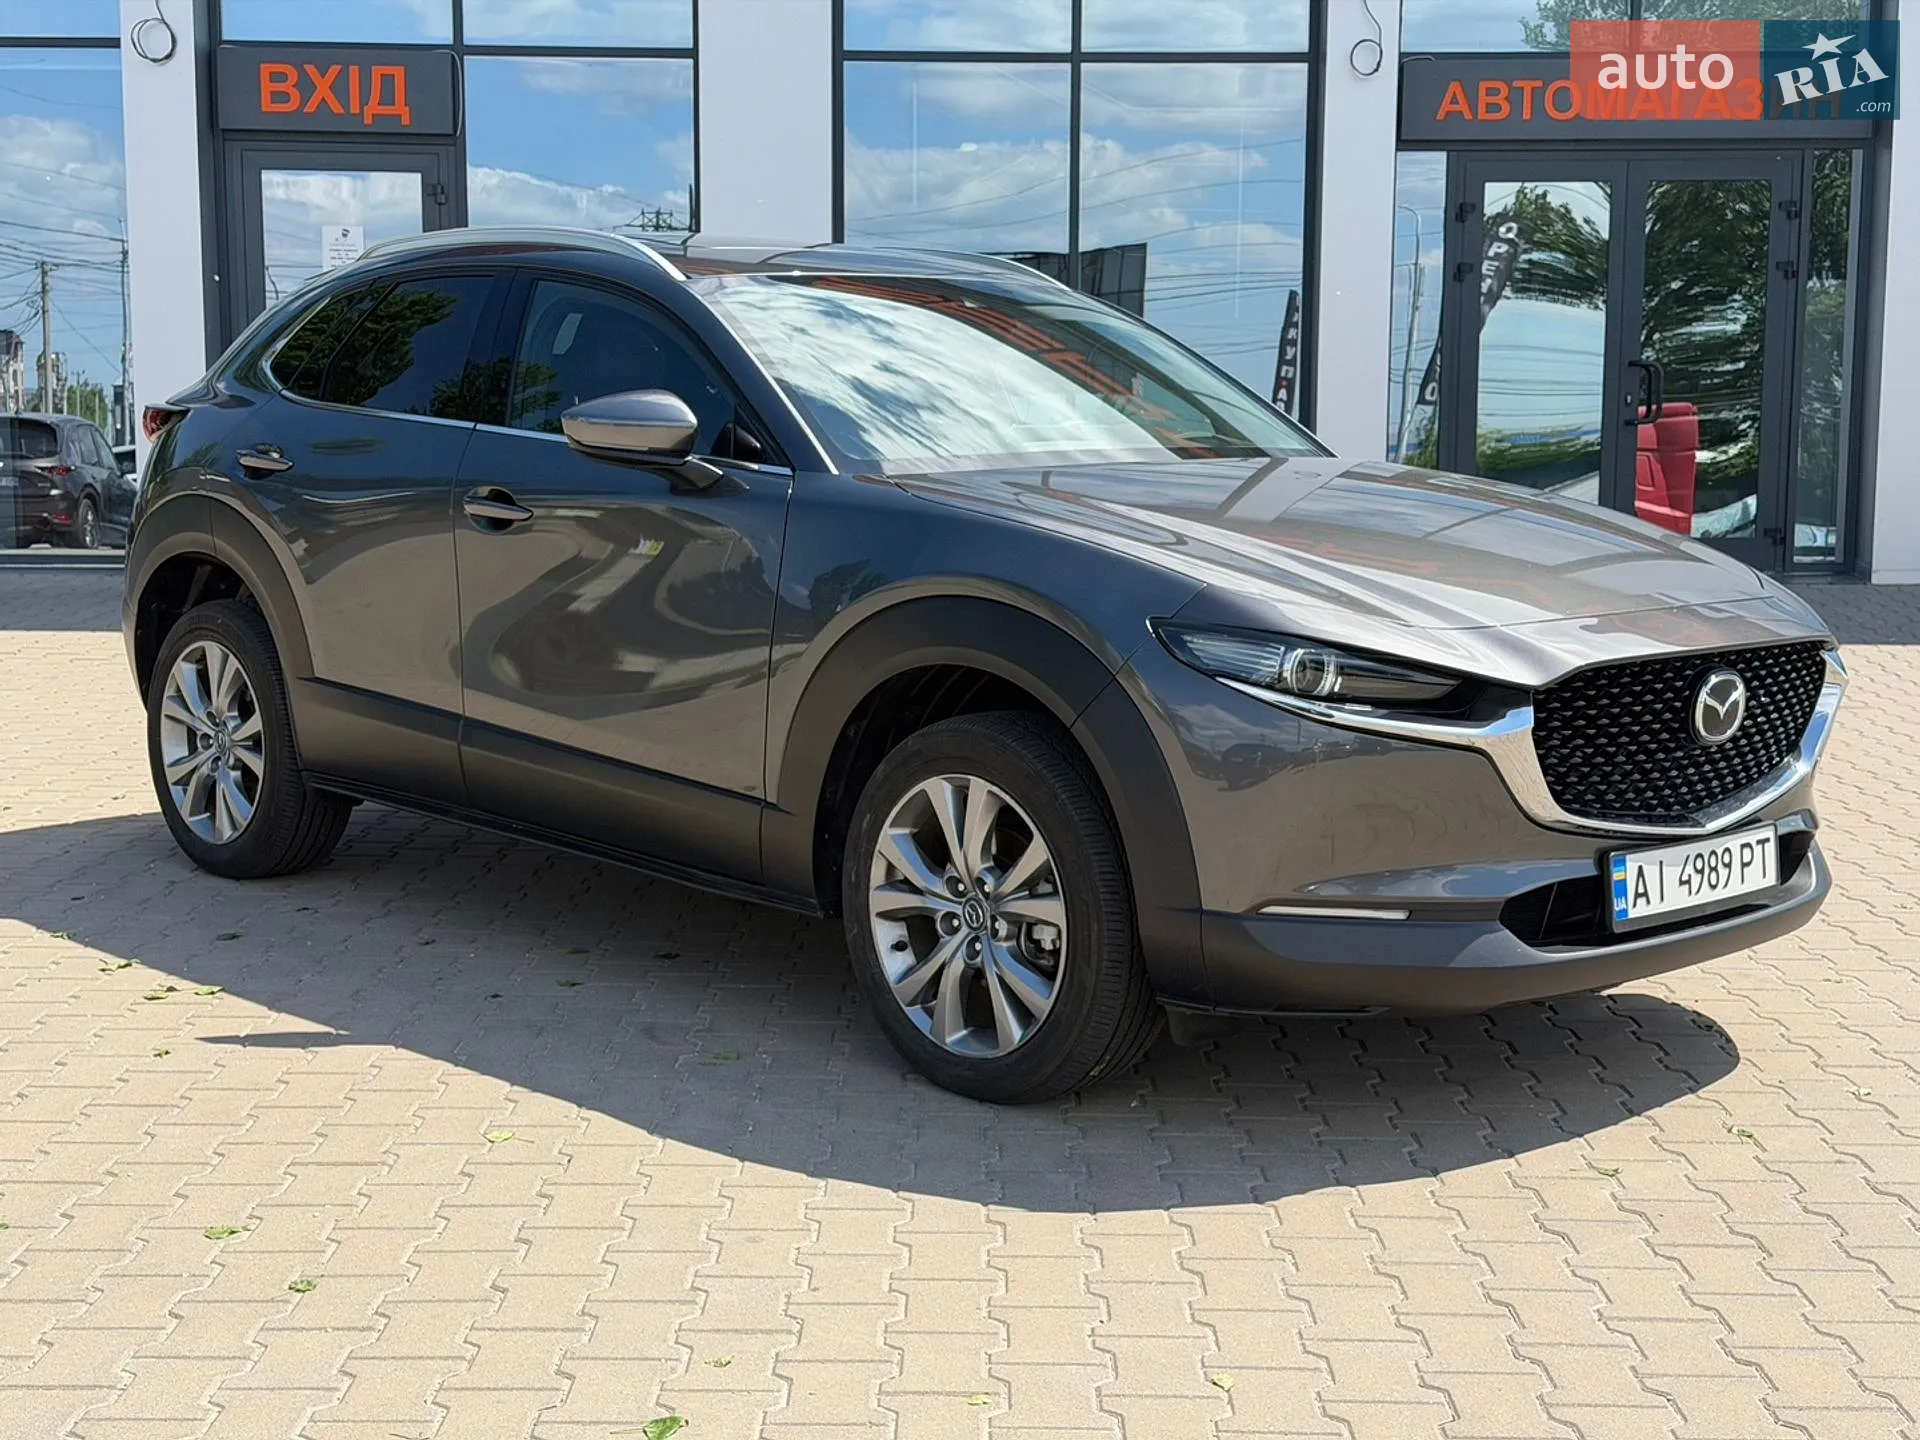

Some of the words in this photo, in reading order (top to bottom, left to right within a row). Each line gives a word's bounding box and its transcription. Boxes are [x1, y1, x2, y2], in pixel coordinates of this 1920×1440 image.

[259, 63, 411, 126] ВХІД
[1614, 896, 1627, 911] UA
[1632, 860, 1665, 908] AI
[1678, 847, 1733, 897] 4989
[1740, 837, 1771, 886] PT
